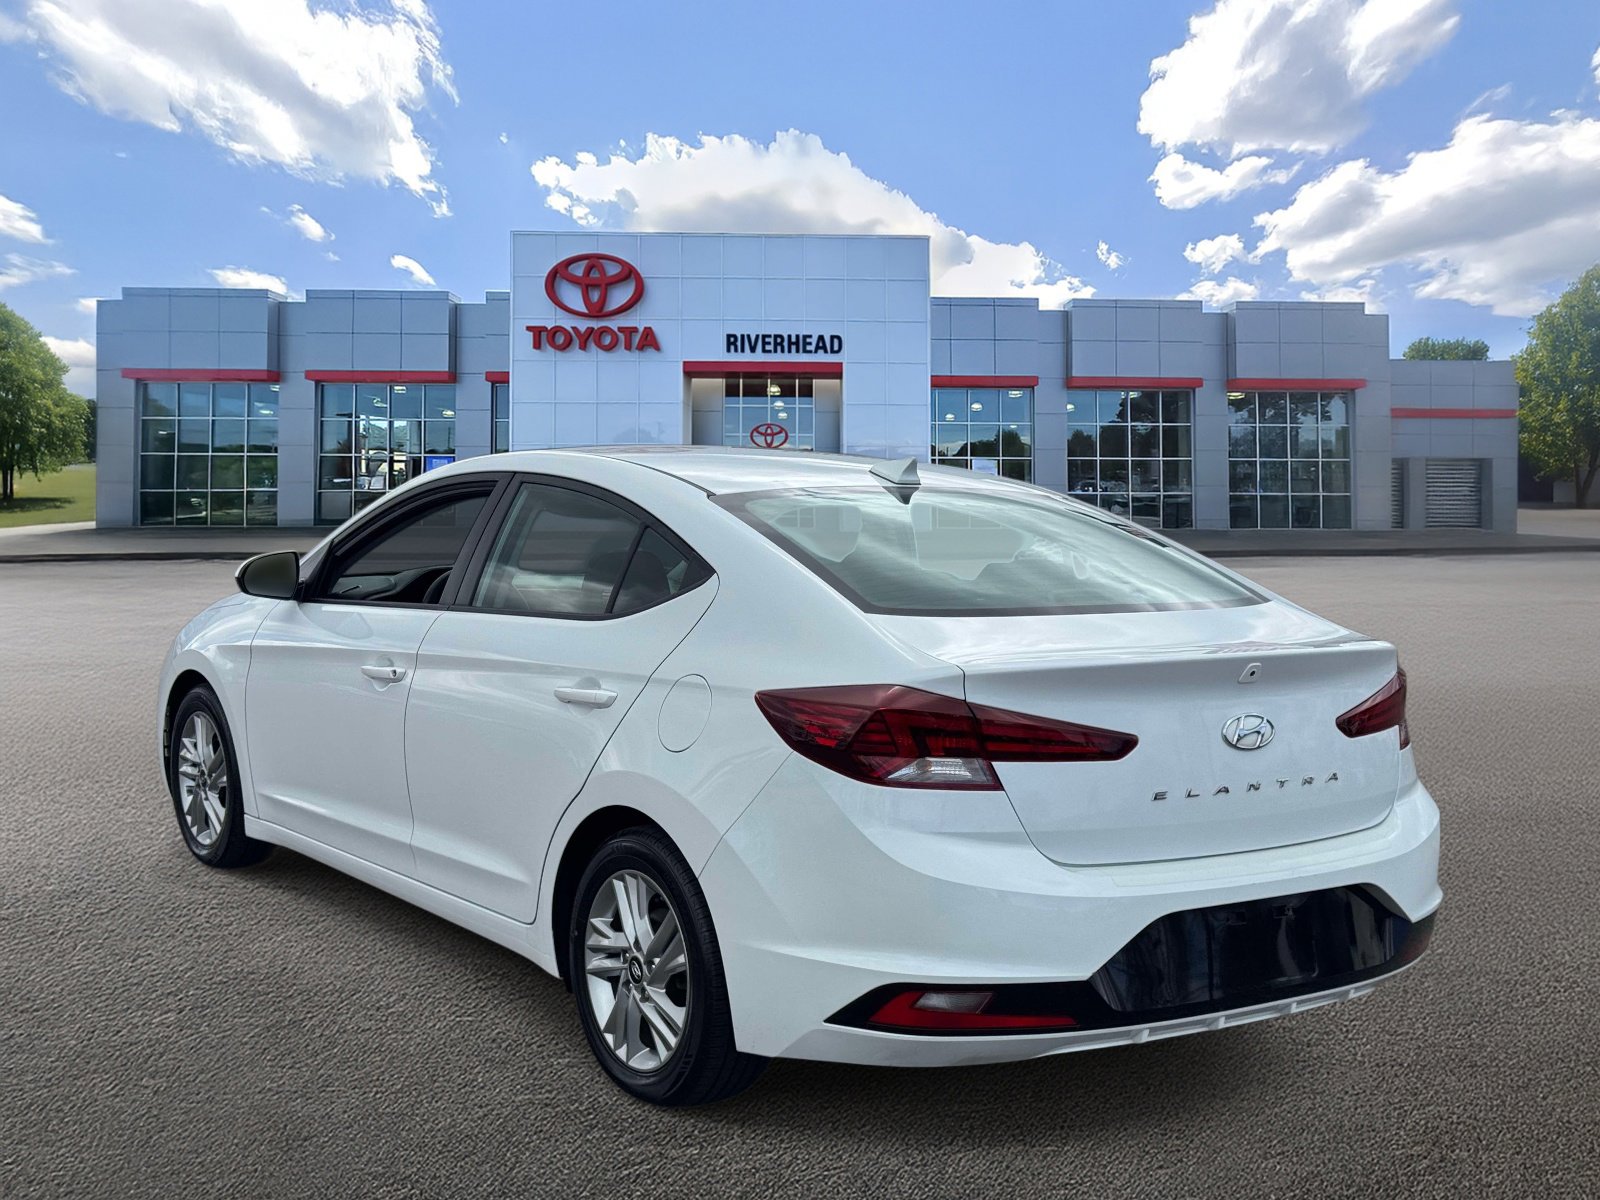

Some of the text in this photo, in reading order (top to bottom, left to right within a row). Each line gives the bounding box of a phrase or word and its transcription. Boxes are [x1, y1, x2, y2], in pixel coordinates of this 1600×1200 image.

[526, 325, 661, 352] TOYOTA
[726, 333, 843, 354] RIVERHEAD
[1151, 771, 1339, 802] ELANTRA
